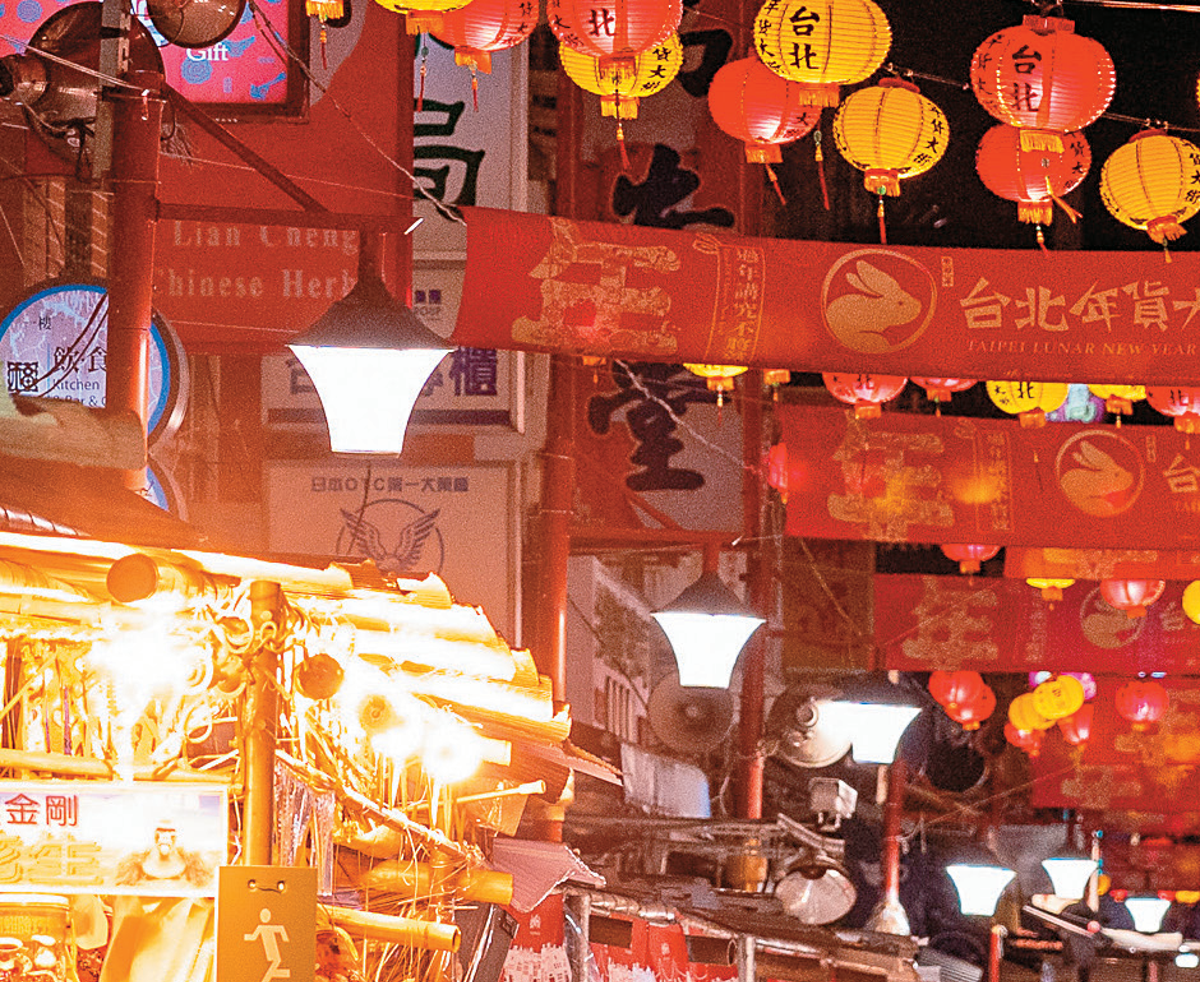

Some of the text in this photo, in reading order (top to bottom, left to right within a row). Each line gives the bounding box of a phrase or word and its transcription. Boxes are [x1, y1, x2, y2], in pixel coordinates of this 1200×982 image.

[588, 8, 616, 37] 北
[186, 42, 228, 61] Gift
[789, 5, 821, 70] 台北
[1011, 44, 1043, 112] 台北
[175, 221, 240, 247] Lian
[157, 270, 264, 297] hinese
[967, 341, 1026, 355] TAIPEI
[1033, 341, 1096, 355] LUNAR
[1102, 342, 1142, 355] NEW
[1150, 342, 1197, 356] YEAR
[4, 793, 79, 826] 金剛
